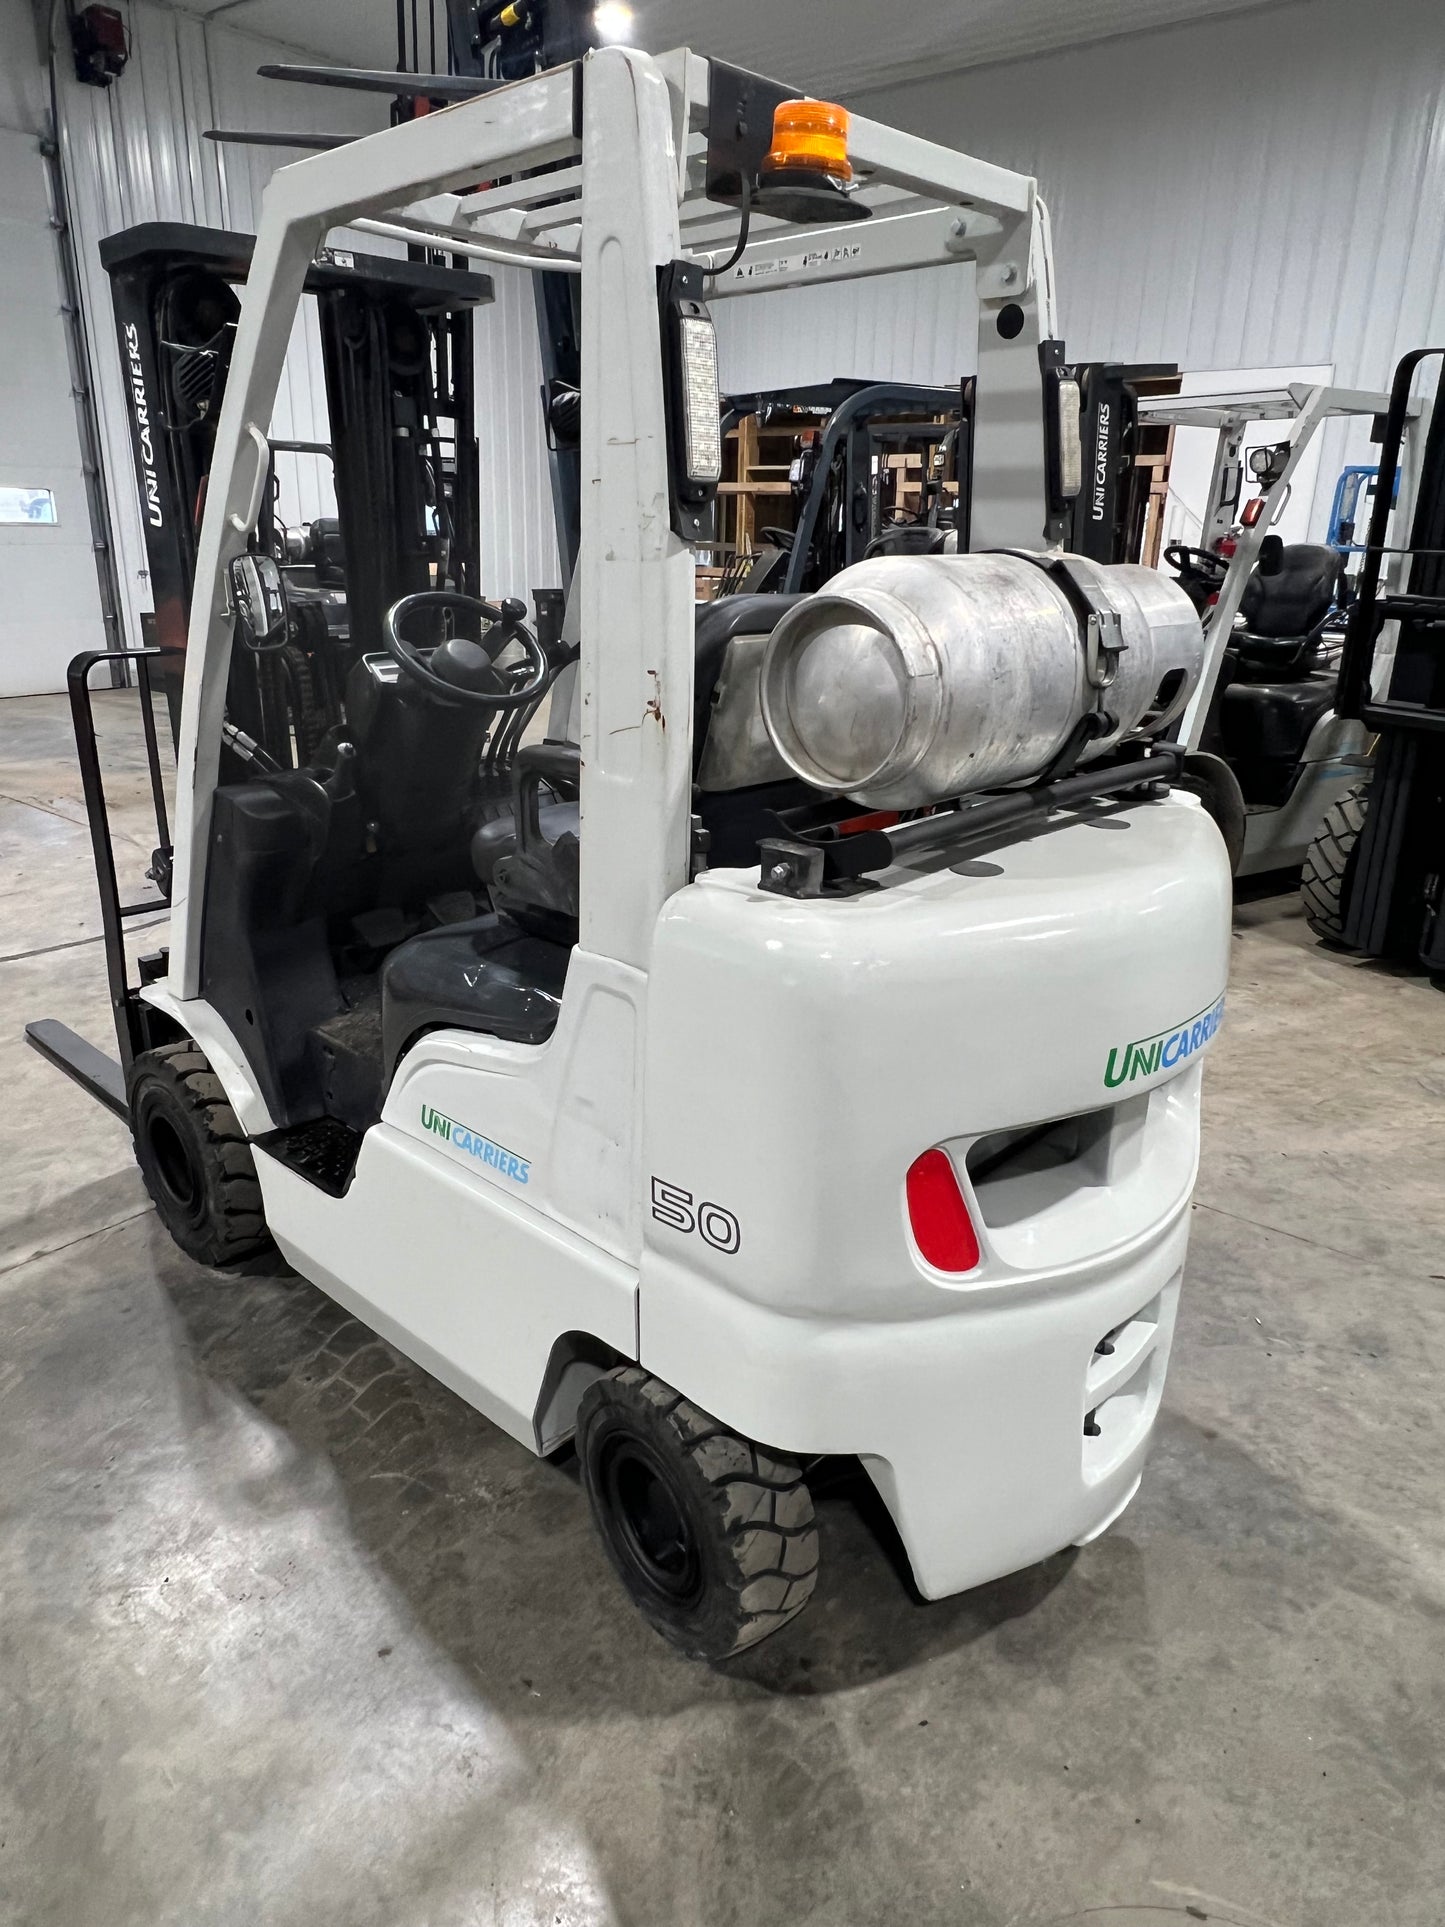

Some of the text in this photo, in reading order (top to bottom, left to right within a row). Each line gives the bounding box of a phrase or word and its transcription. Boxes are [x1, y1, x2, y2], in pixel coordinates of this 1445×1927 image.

[125, 322, 163, 527] UNICARRIERS
[1093, 402, 1110, 520] UNICARRIERS
[421, 1104, 531, 1184] UNICARRIERS
[651, 1176, 740, 1254] 50
